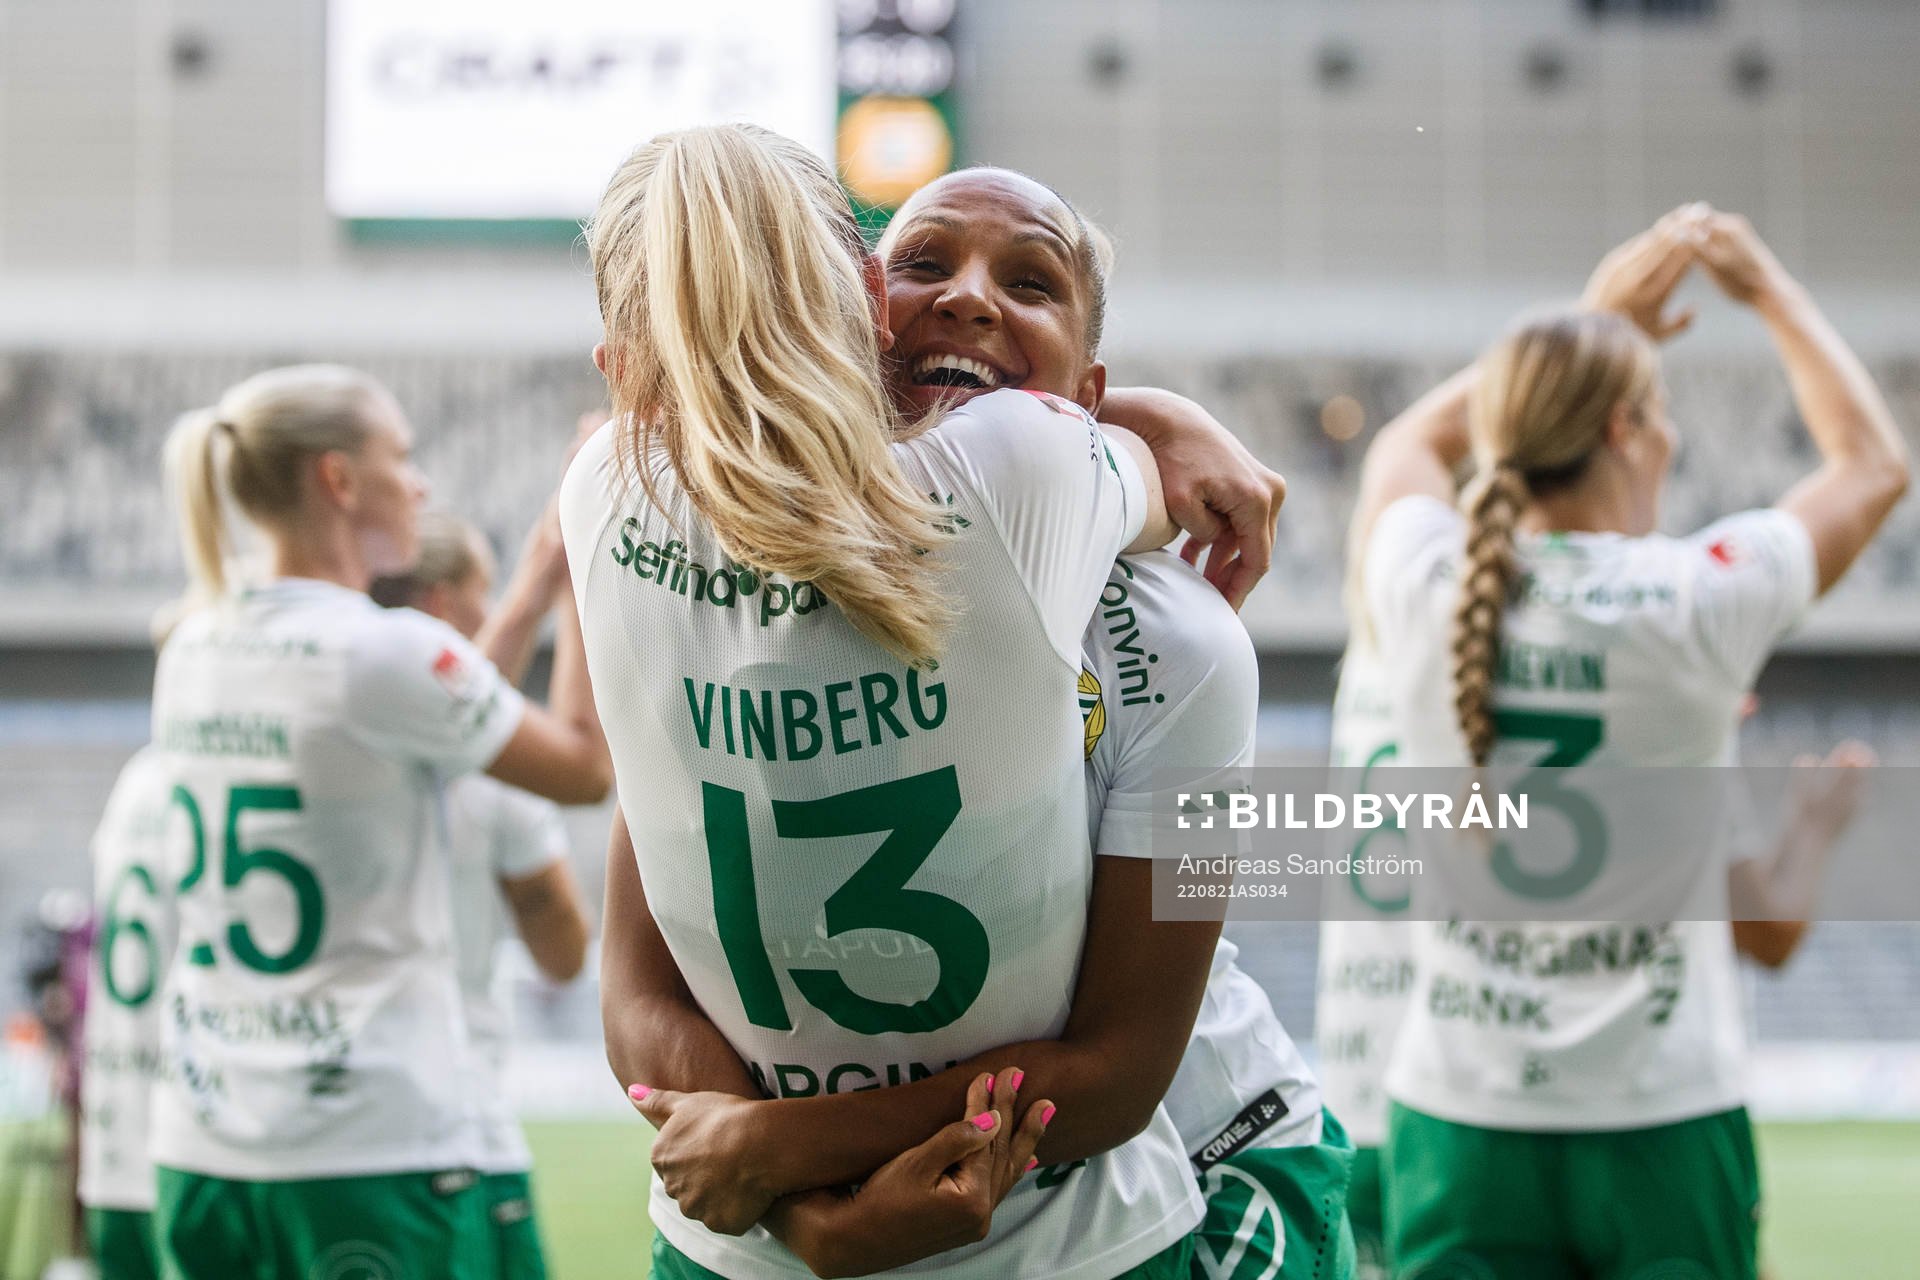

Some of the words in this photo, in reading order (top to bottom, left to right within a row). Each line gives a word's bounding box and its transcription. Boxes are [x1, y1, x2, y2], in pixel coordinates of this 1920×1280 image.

[611, 517, 737, 609] Sefina
[761, 579, 828, 627] pa
[684, 660, 948, 761] VINBERG
[1488, 707, 1611, 904] 3
[702, 765, 990, 1035] 13
